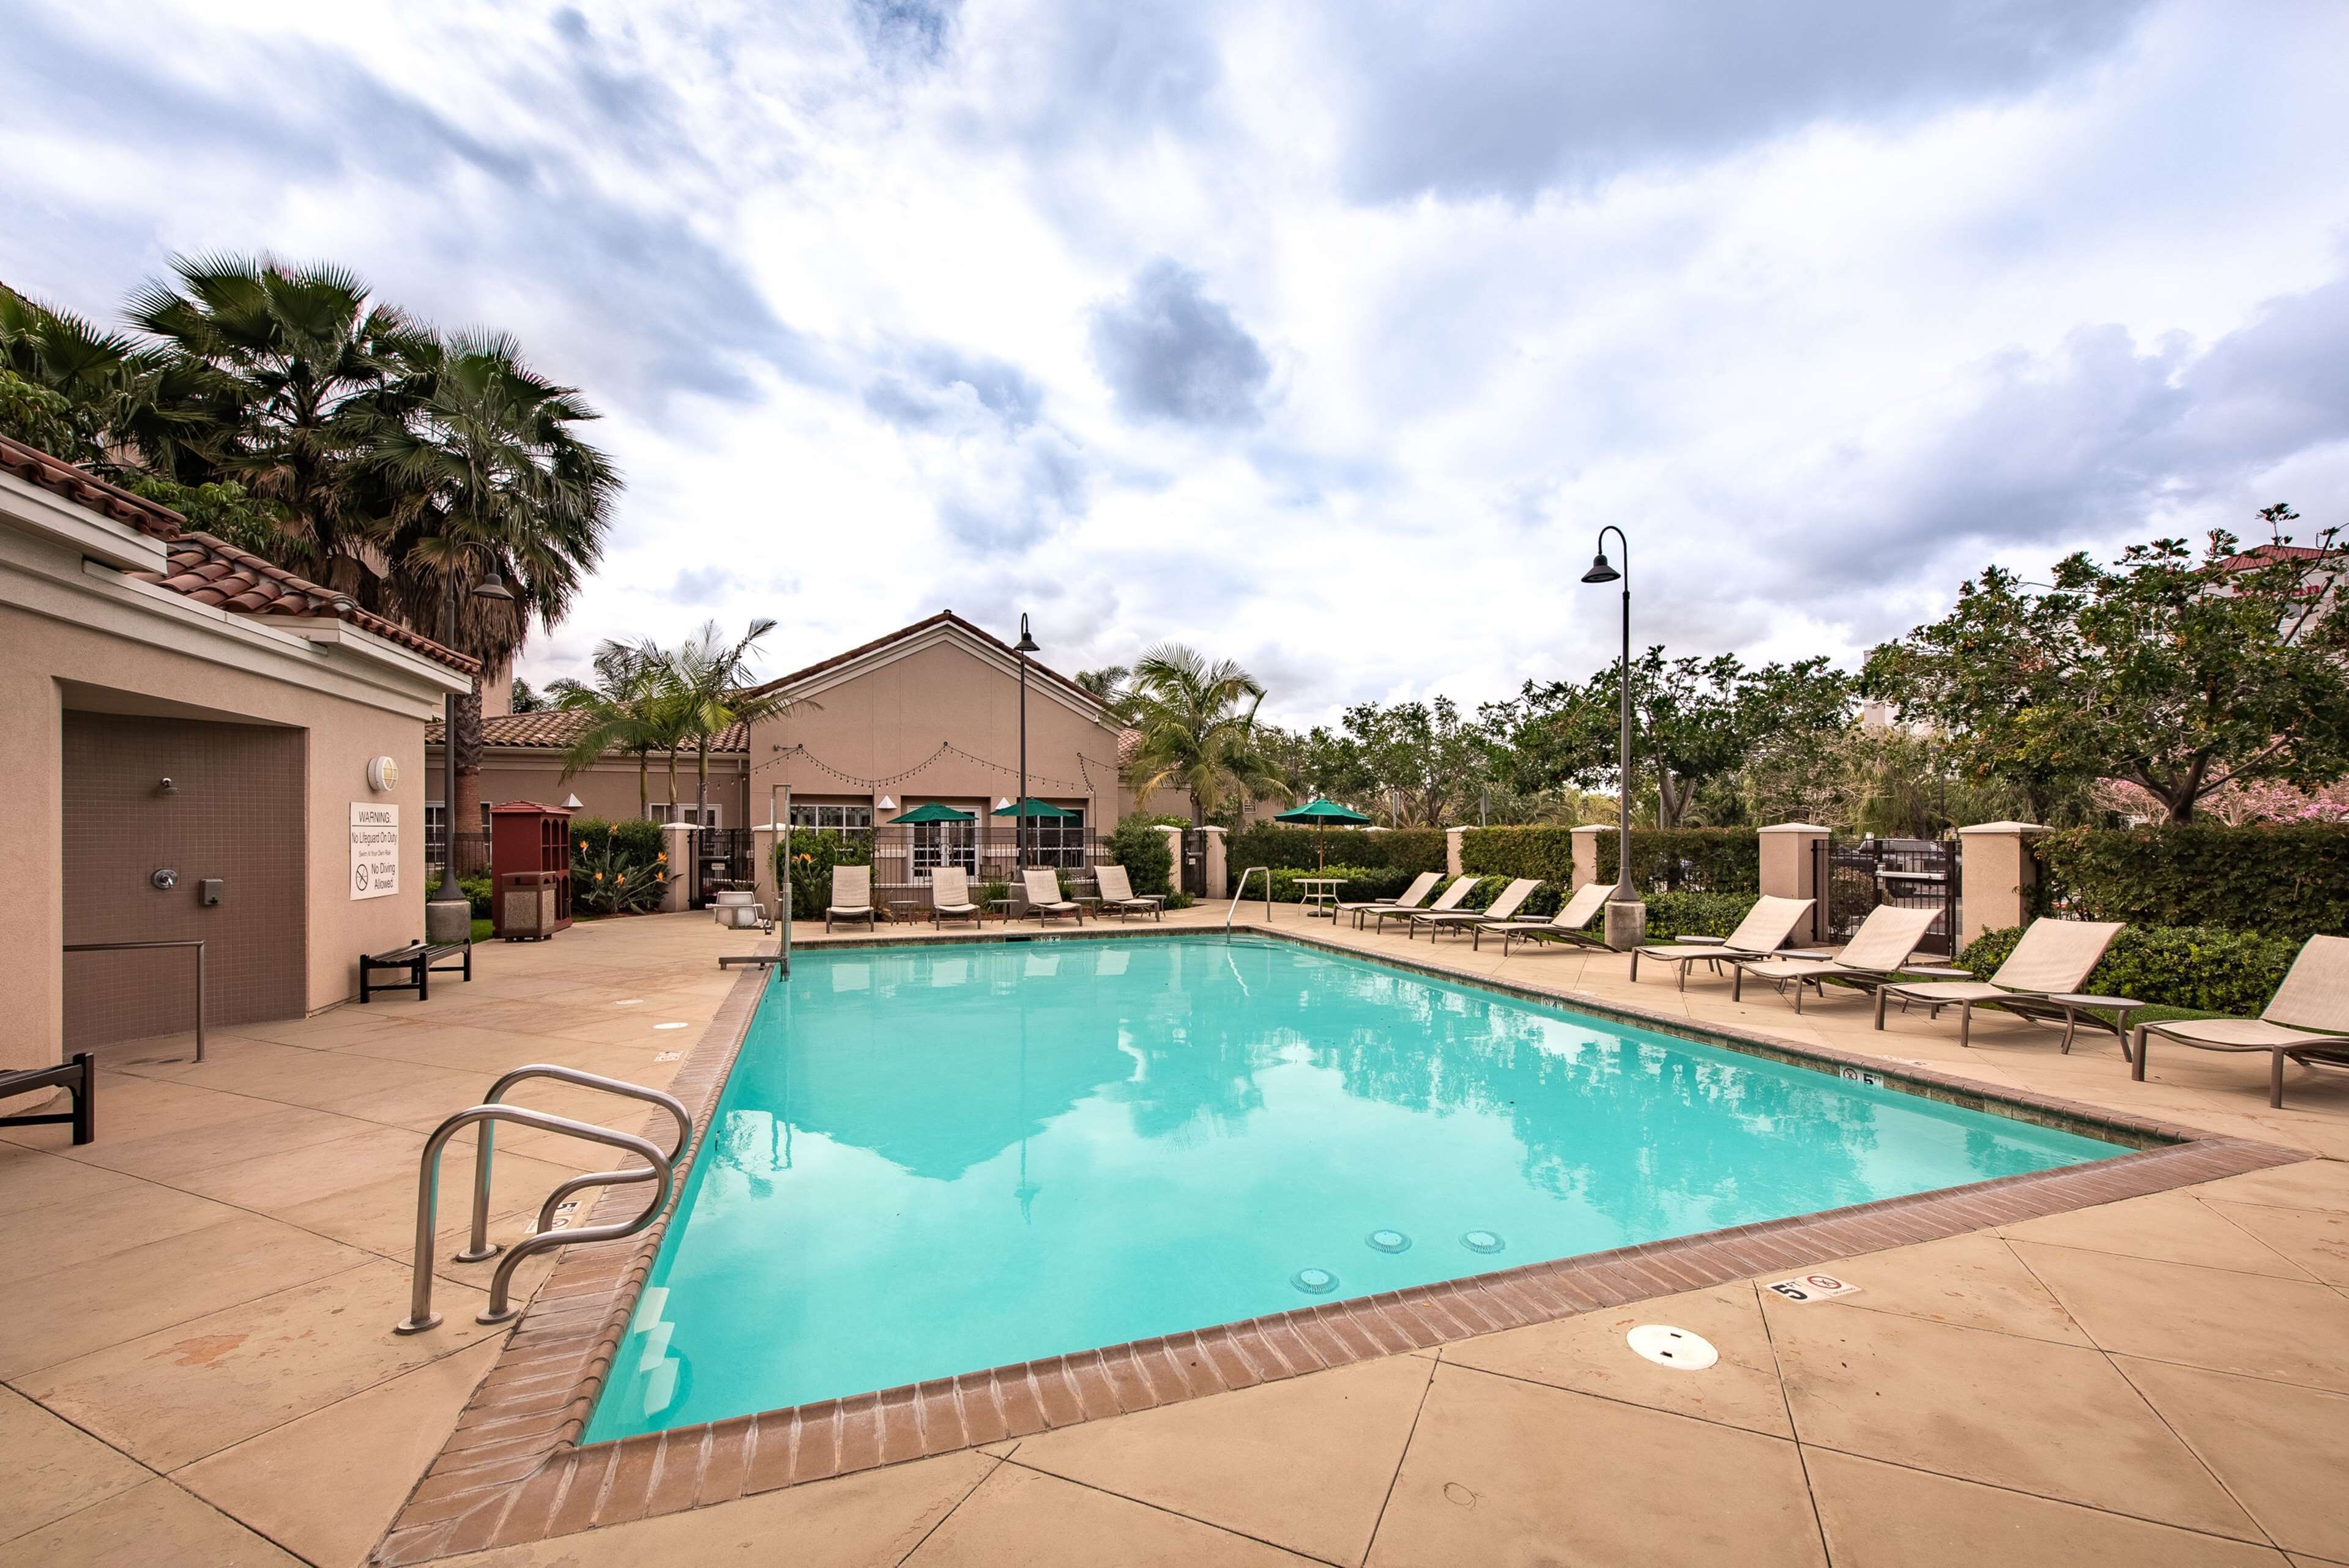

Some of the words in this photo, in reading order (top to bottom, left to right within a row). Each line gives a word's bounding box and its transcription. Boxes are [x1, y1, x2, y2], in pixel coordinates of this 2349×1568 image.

[359, 811, 392, 823] WARNING:
[352, 831, 359, 844] No
[359, 831, 380, 846] Lifeguard
[381, 831, 387, 843] On
[387, 831, 398, 845] Duty
[371, 863, 379, 874] No
[380, 862, 395, 875] Diving
[374, 877, 393, 890] Allowed
[1770, 1284, 1807, 1299] 5
